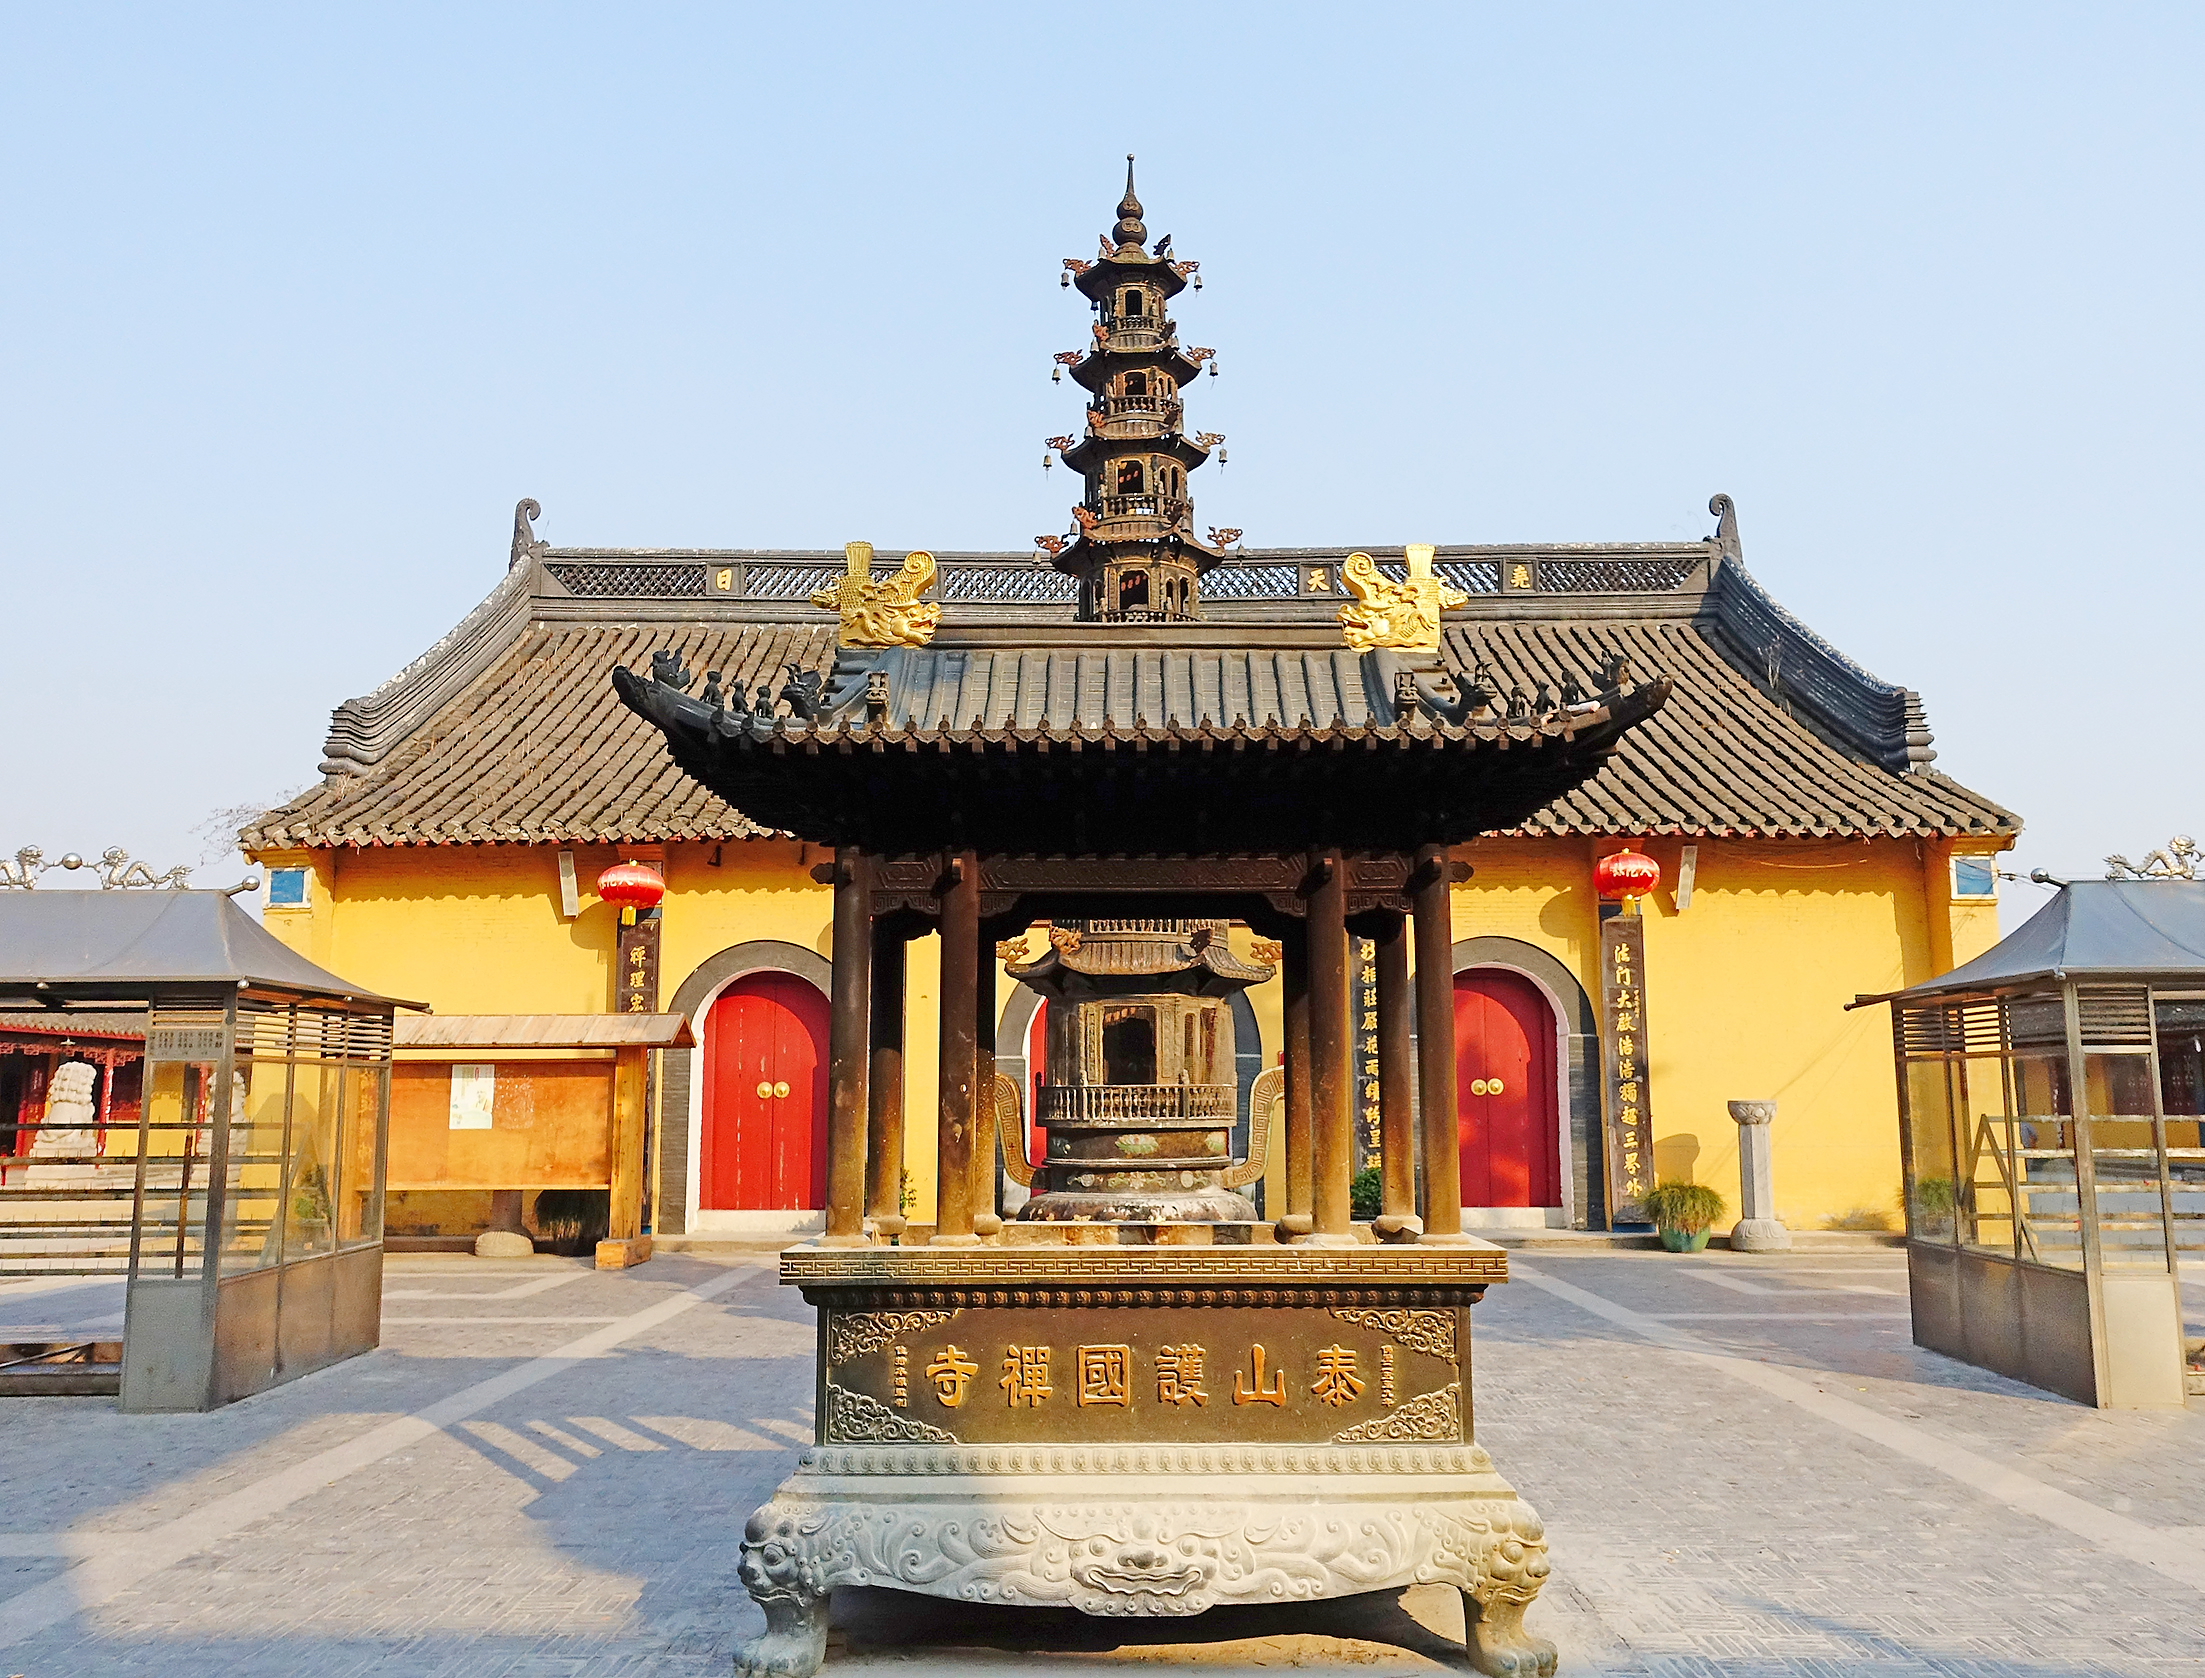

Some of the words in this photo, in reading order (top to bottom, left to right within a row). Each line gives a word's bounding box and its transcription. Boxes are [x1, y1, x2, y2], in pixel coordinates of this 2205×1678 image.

[716, 568, 733, 591] 日
[1307, 568, 1330, 592] 天
[925, 1344, 1366, 1408] 泰山護國禪寺
